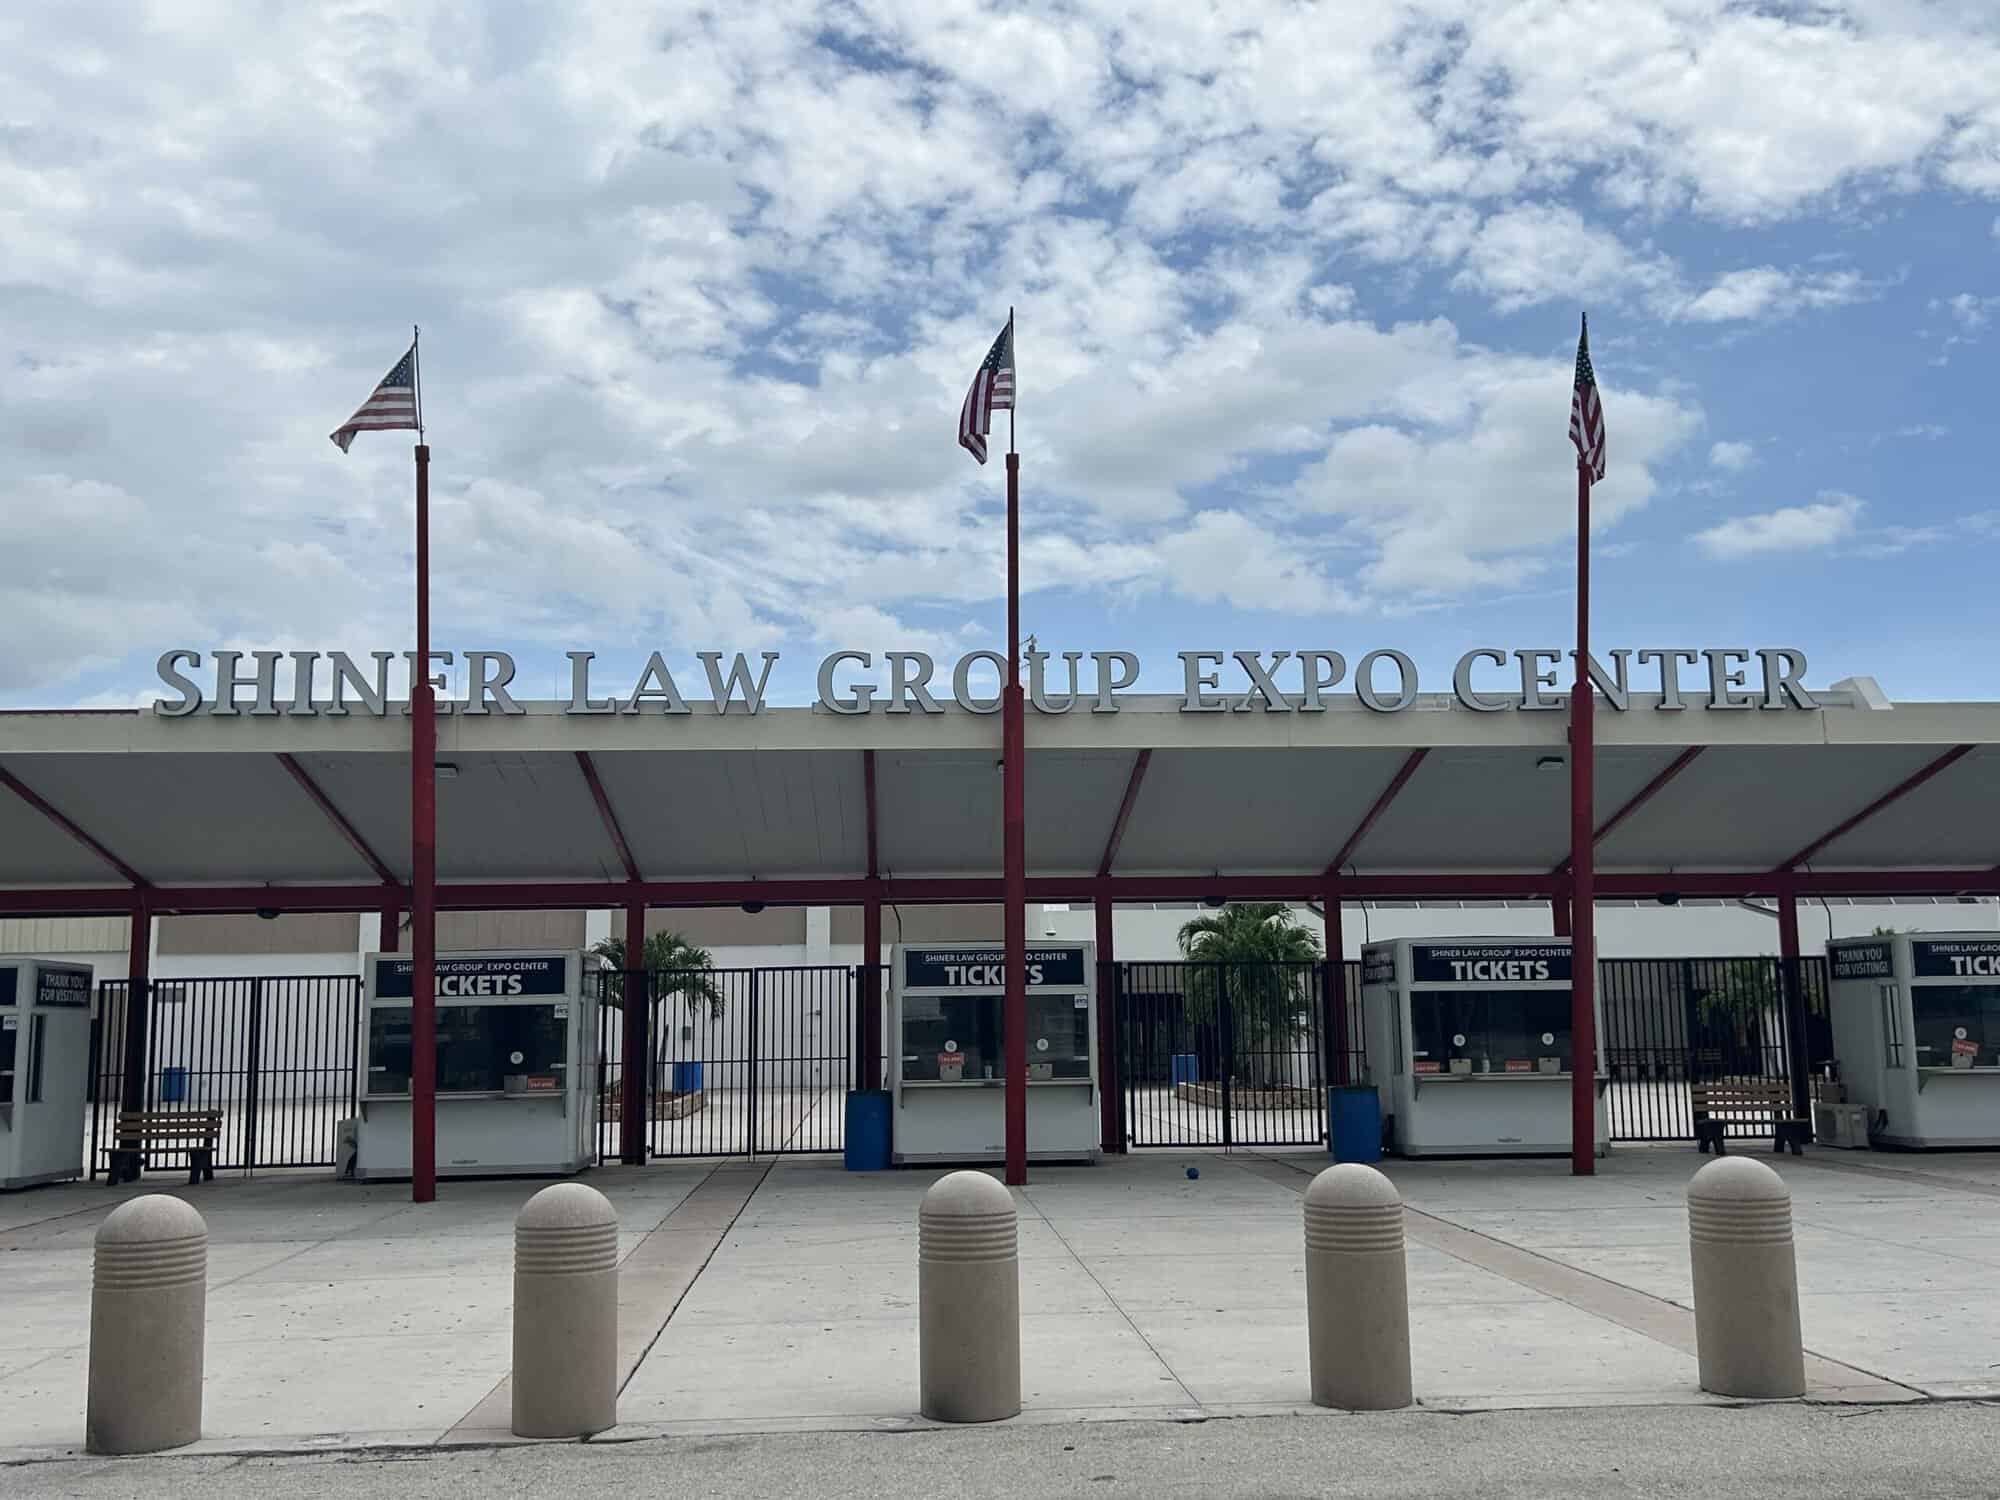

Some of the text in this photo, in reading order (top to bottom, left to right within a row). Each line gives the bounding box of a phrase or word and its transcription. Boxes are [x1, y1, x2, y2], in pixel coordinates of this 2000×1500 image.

[153, 647, 1822, 717] SHINER LAW GROUP EXPO CENTER
[1432, 948, 1572, 957] SHINER LAW GROUP EXPO CENTER
[1838, 947, 1882, 962] THANK YOU
[1931, 944, 1960, 953] SHINER
[1961, 944, 1979, 952] LAW
[925, 953, 956, 962] SHINER
[957, 953, 975, 961] LAW
[1034, 952, 1068, 961] CENTER
[435, 963, 450, 972] AW
[452, 963, 483, 971] GROUP
[487, 962, 512, 971] EXPO
[513, 962, 548, 971] CENTER
[1451, 961, 1550, 980] TICKETS
[1835, 962, 1851, 976] FOR
[46, 975, 85, 989] THANK YOU
[944, 965, 1043, 985] TICKS
[435, 975, 522, 995] ICKETS
[40, 988, 55, 1001] FOR
